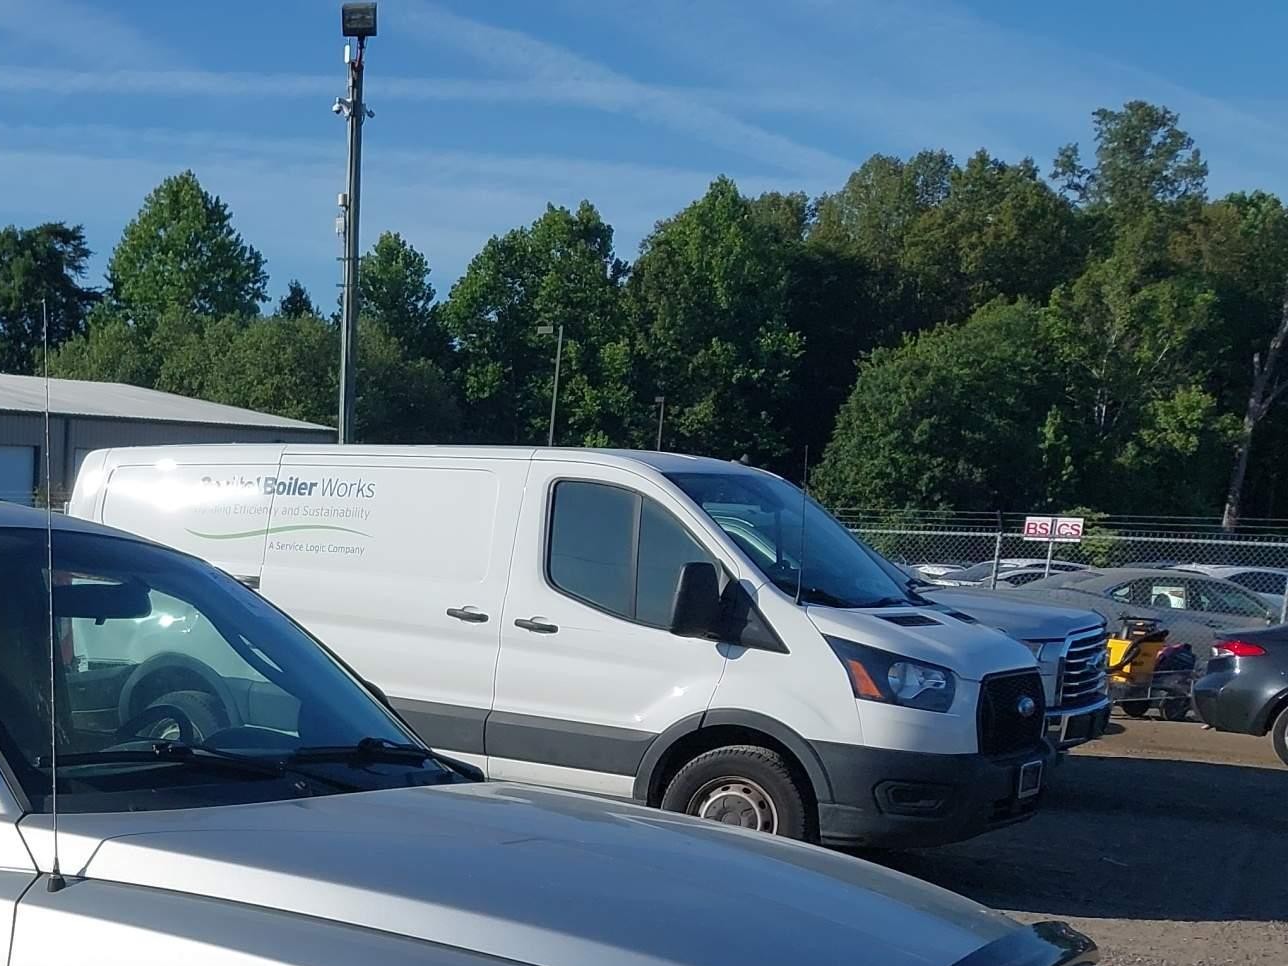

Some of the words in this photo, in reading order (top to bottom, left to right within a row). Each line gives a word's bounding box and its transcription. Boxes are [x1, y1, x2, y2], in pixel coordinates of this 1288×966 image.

[263, 476, 318, 496] Boiler
[321, 477, 376, 499] Works
[233, 503, 279, 517] Efficieny
[281, 506, 300, 516] and
[302, 505, 371, 520] Sustainability
[1026, 522, 1050, 536] BS
[268, 541, 275, 551] A
[276, 541, 304, 552] Service
[306, 543, 325, 554] Logic
[327, 544, 365, 555] Company
